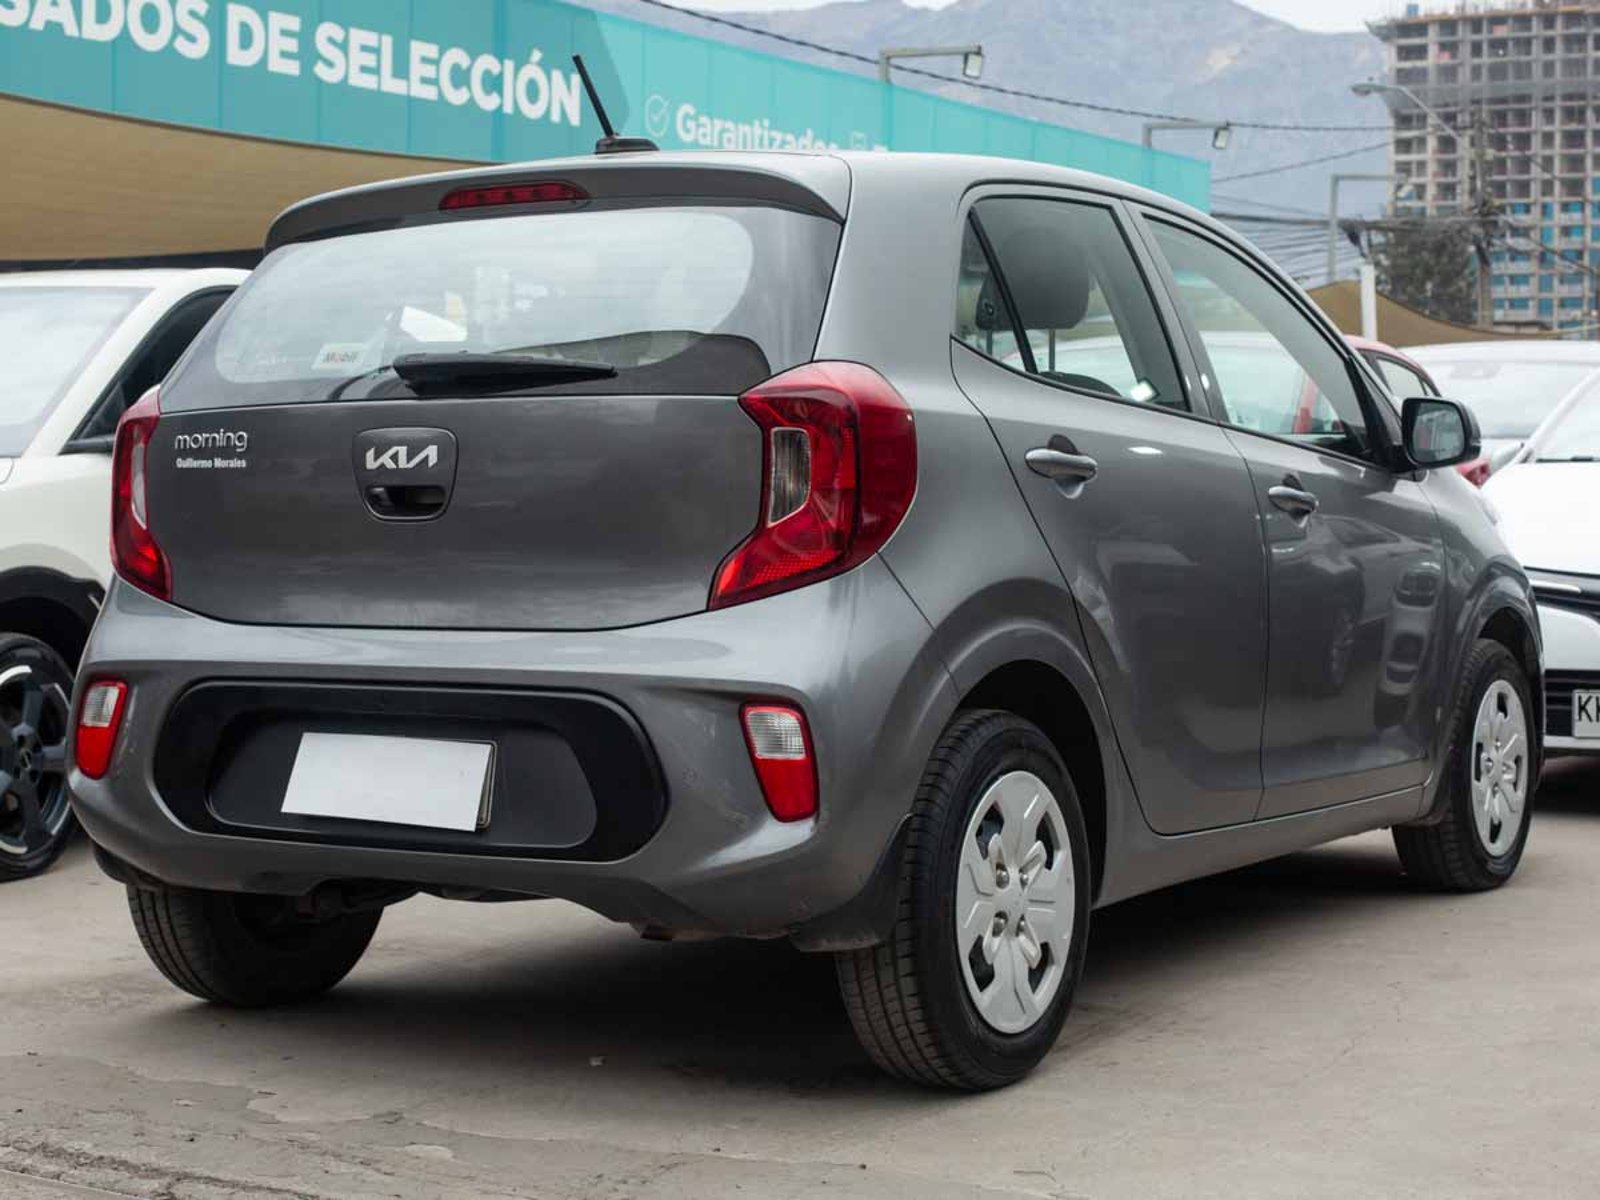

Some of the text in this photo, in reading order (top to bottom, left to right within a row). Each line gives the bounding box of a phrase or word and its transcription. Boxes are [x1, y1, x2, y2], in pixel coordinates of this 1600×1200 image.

[227, 3, 300, 76] DE
[314, 22, 581, 127] SELECCIÓN
[175, 428, 248, 452] morning
[176, 457, 247, 469] Guillermo Morales
[365, 445, 438, 470] KIA
